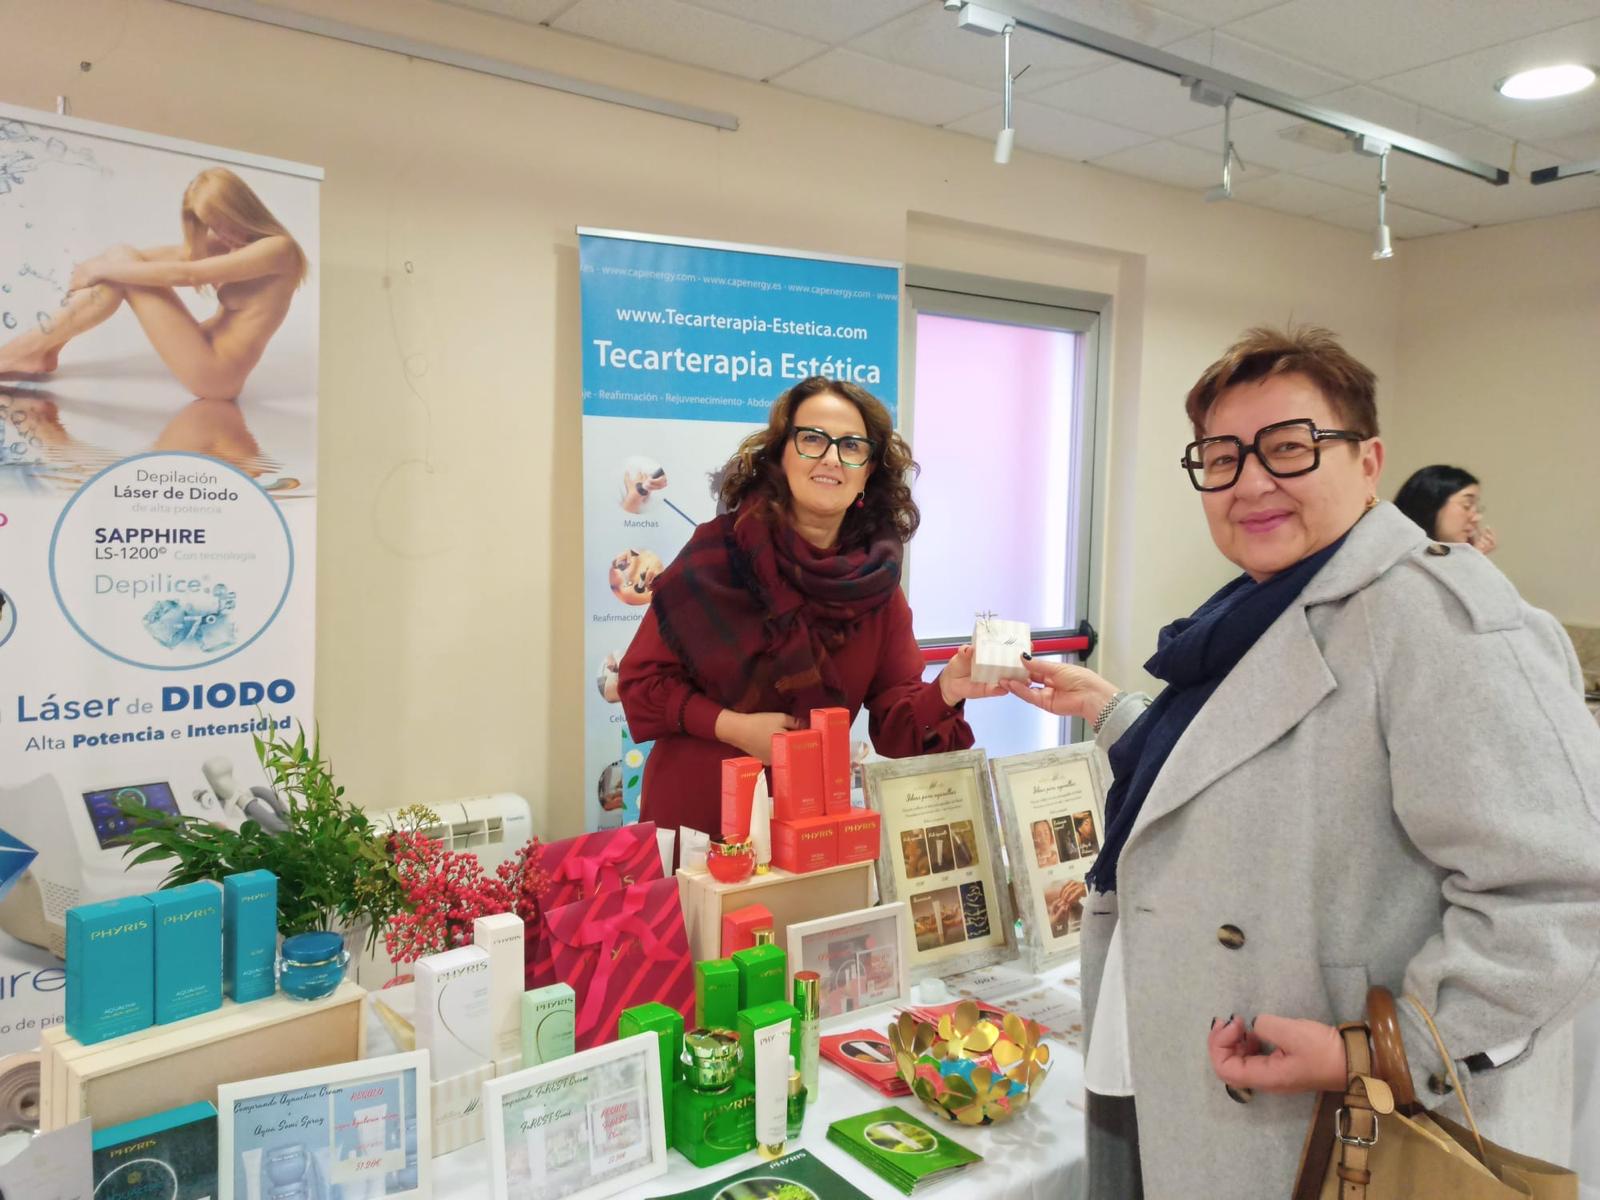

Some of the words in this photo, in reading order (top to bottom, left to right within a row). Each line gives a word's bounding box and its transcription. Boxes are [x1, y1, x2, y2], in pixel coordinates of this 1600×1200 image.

[703, 276, 782, 291] www.capenergy.es
[788, 284, 871, 299] www.capenergy.com
[616, 307, 868, 341] www.Tecarterapia-Estetica.com
[593, 339, 773, 382] Tecarterapia
[781, 351, 881, 384] Estética
[599, 389, 658, 402] Reafirmación
[137, 469, 217, 485] Depilación
[114, 485, 159, 499] Láser
[163, 486, 184, 500] de
[189, 487, 239, 501] Diodo
[173, 504, 223, 515] potencia
[623, 519, 660, 529] Manchas
[95, 527, 206, 544] SAPPHIRE
[17, 693, 120, 722] Láser
[126, 697, 153, 715] de
[162, 678, 296, 712] DIODO
[25, 735, 66, 752] Alta
[73, 726, 165, 749] Potencia
[171, 729, 182, 740] e
[187, 715, 292, 739] Intensidad
[801, 828, 833, 840] PHYRIS
[844, 822, 877, 833] PHYRIS
[163, 906, 216, 926] PHYRIS
[90, 920, 148, 941] PHYRIS
[437, 960, 488, 984] PHYRIS
[535, 997, 574, 1012] PHYRIS
[16, 1018, 36, 1031] de
[109, 1139, 157, 1158] PHYRIS
[769, 1152, 807, 1169] PHYRIS
